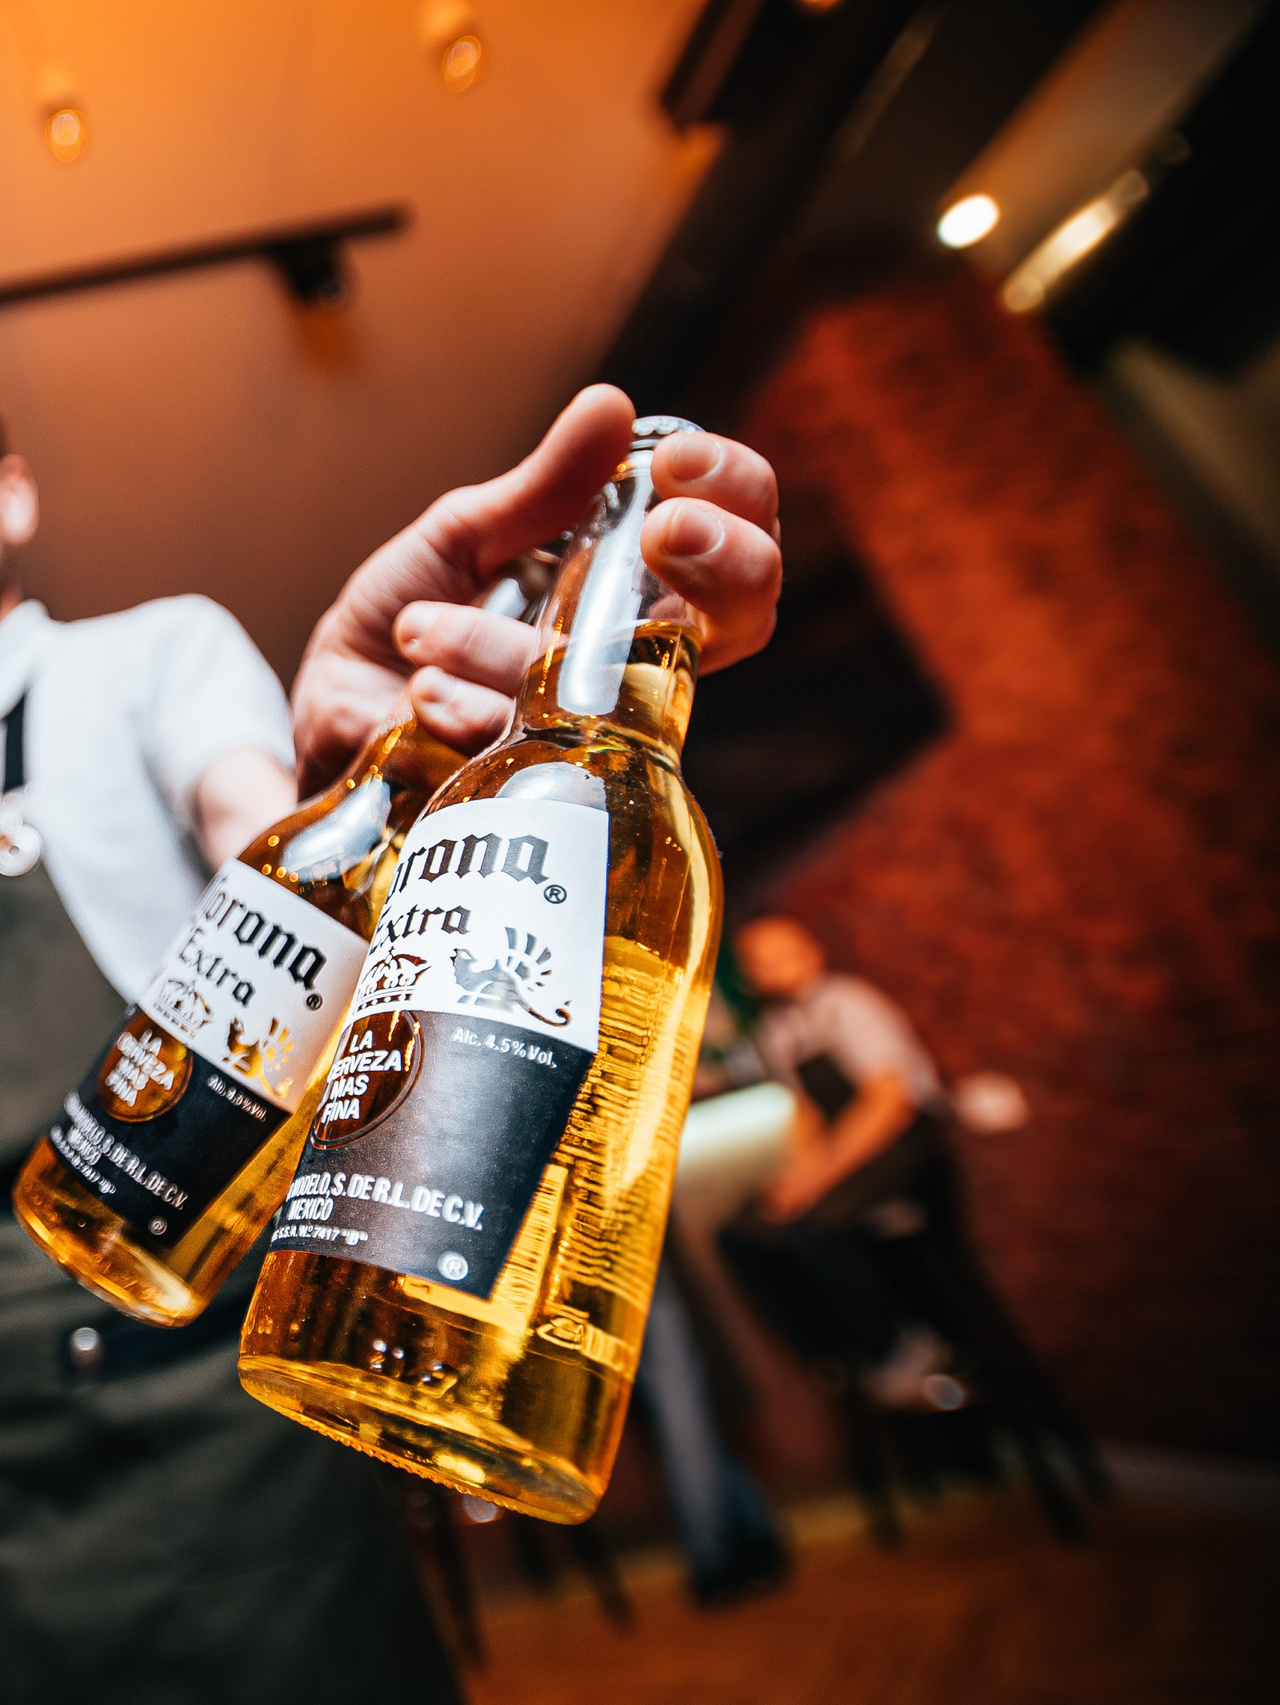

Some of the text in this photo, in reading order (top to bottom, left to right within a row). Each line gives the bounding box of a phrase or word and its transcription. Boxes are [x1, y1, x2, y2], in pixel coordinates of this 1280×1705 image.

[385, 833, 549, 905] rona
[179, 926, 256, 1008] Extra
[349, 1030, 373, 1054] LA
[451, 1026, 482, 1047] Alc.
[330, 1073, 370, 1100] MAS
[321, 1098, 360, 1124] FINA
[287, 1198, 333, 1221] MEXICO
[442, 1193, 485, 1231] C.V.
